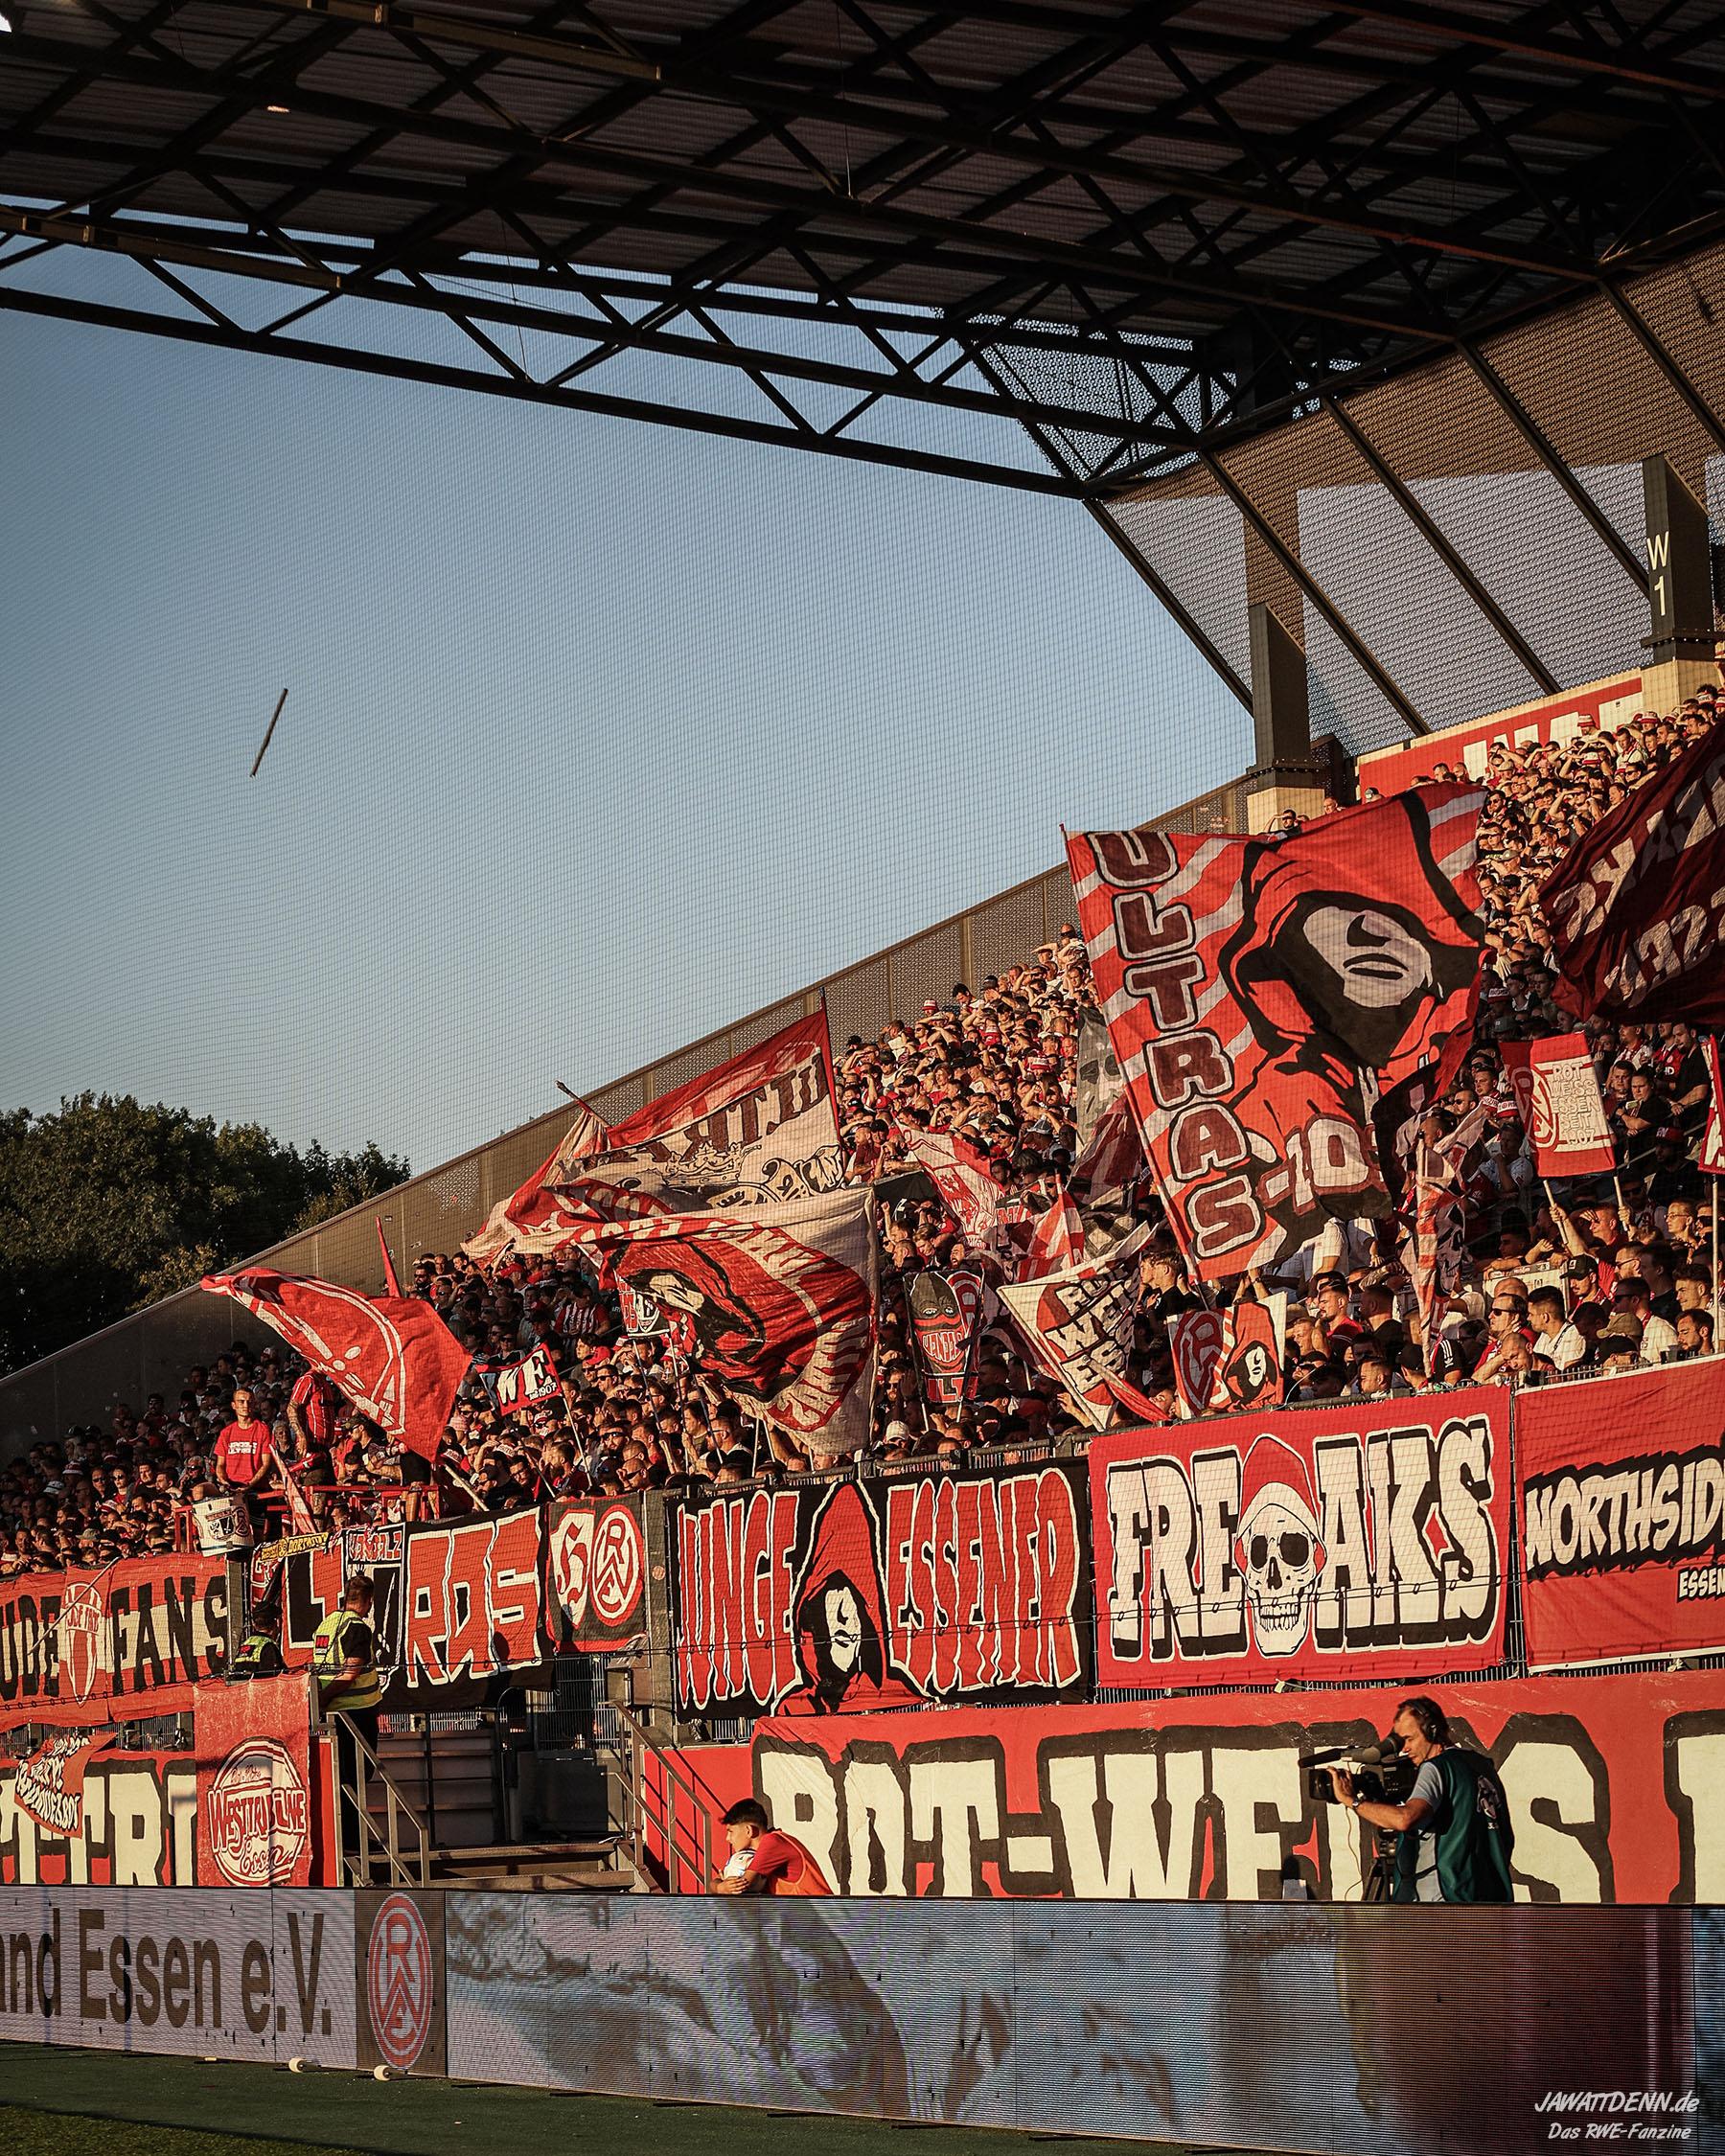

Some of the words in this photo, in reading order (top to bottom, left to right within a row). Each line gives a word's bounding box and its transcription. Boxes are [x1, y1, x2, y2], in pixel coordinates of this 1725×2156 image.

[1088, 831, 1267, 1258] ULTRAS
[1551, 1079, 1599, 1099] WEISS
[1552, 1061, 1584, 1083] ROT
[1551, 1095, 1601, 1114] ESSEN
[1559, 1112, 1592, 1131] SEIT
[539, 1381, 558, 1398] 1907
[1109, 1414, 1496, 1663] FREAKS
[1525, 1457, 1725, 1572] NORTHSID
[110, 1575, 229, 1697] FANS
[678, 1491, 801, 1710] JUNGE
[885, 1467, 1081, 1694] ESSENER
[0, 1908, 60, 2016] nd
[80, 1908, 222, 2029] Essen
[242, 1913, 332, 2035] e.V.
